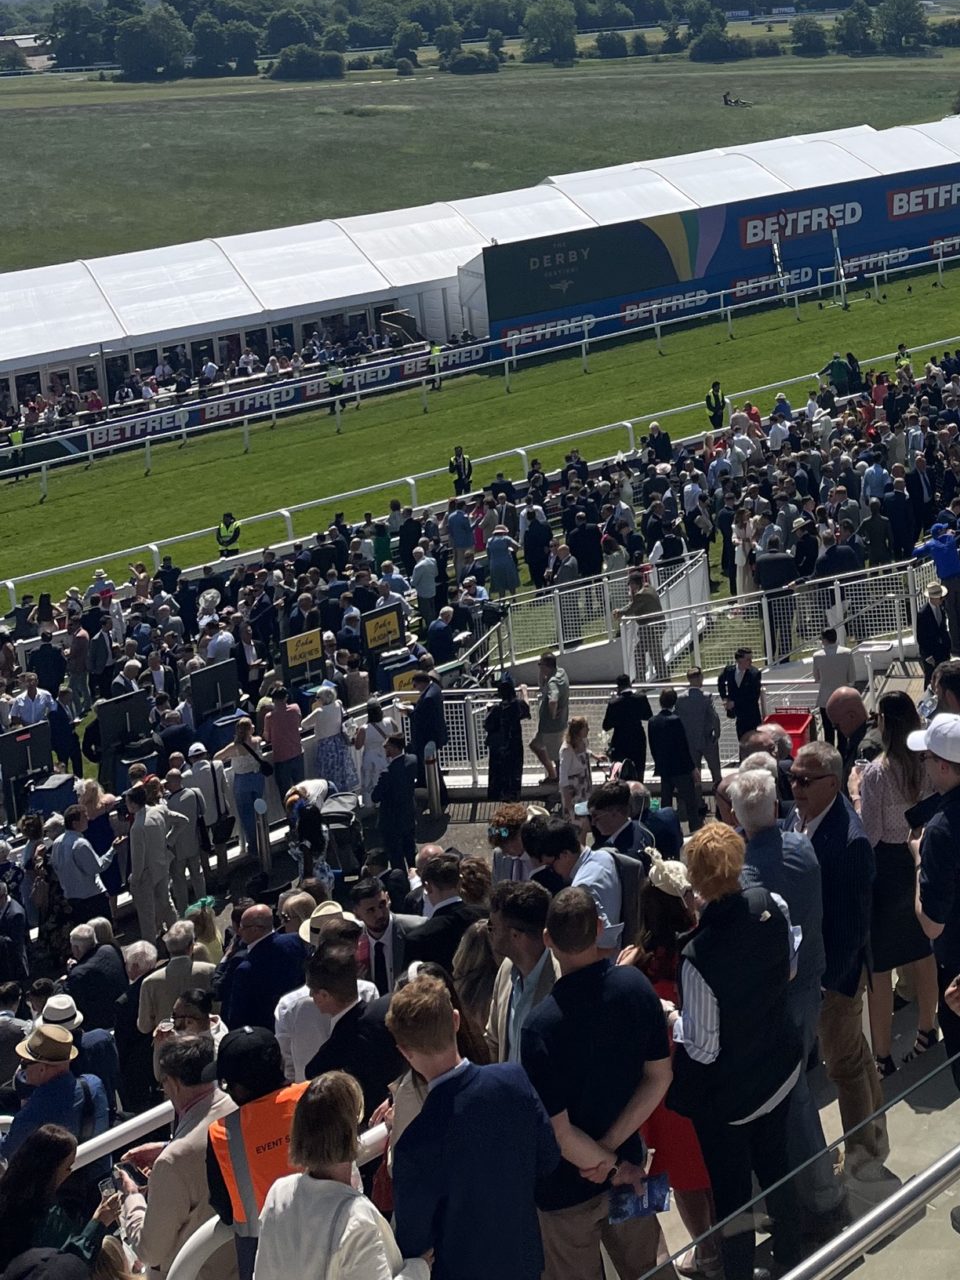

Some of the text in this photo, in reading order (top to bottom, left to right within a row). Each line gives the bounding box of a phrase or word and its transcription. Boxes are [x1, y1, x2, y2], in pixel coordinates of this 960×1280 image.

[746, 202, 863, 244] BETFRED
[529, 248, 590, 270] DERBY
[624, 289, 709, 322] BETFRED
[403, 345, 484, 376] BEFRED
[306, 366, 390, 397] BEFRED
[205, 387, 295, 419] BETFRED
[255, 1137, 283, 1155] EVENT
